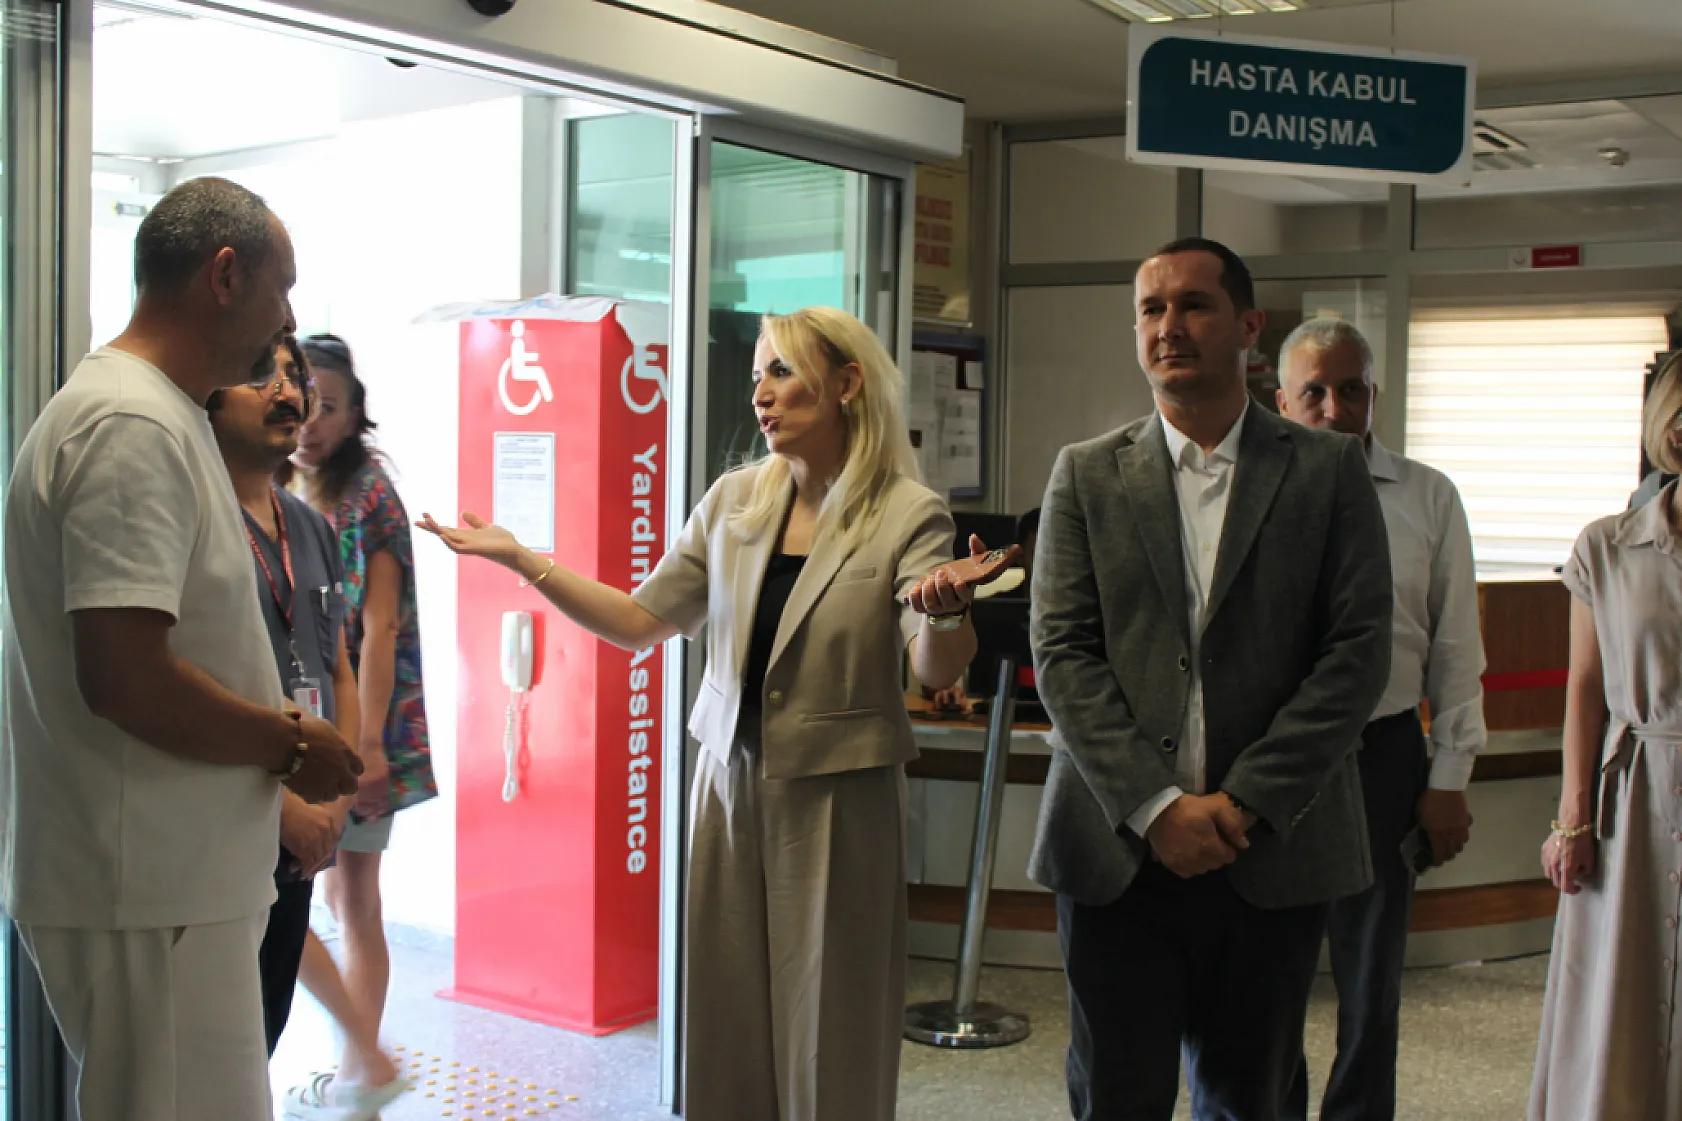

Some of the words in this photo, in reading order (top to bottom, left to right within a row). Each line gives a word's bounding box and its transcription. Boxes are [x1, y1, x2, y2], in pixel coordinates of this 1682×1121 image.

[1190, 59, 1297, 94] HASTA
[1308, 71, 1416, 104] KABUL
[1230, 110, 1377, 150] DANIŞMA
[626, 645, 655, 874] Assistance
